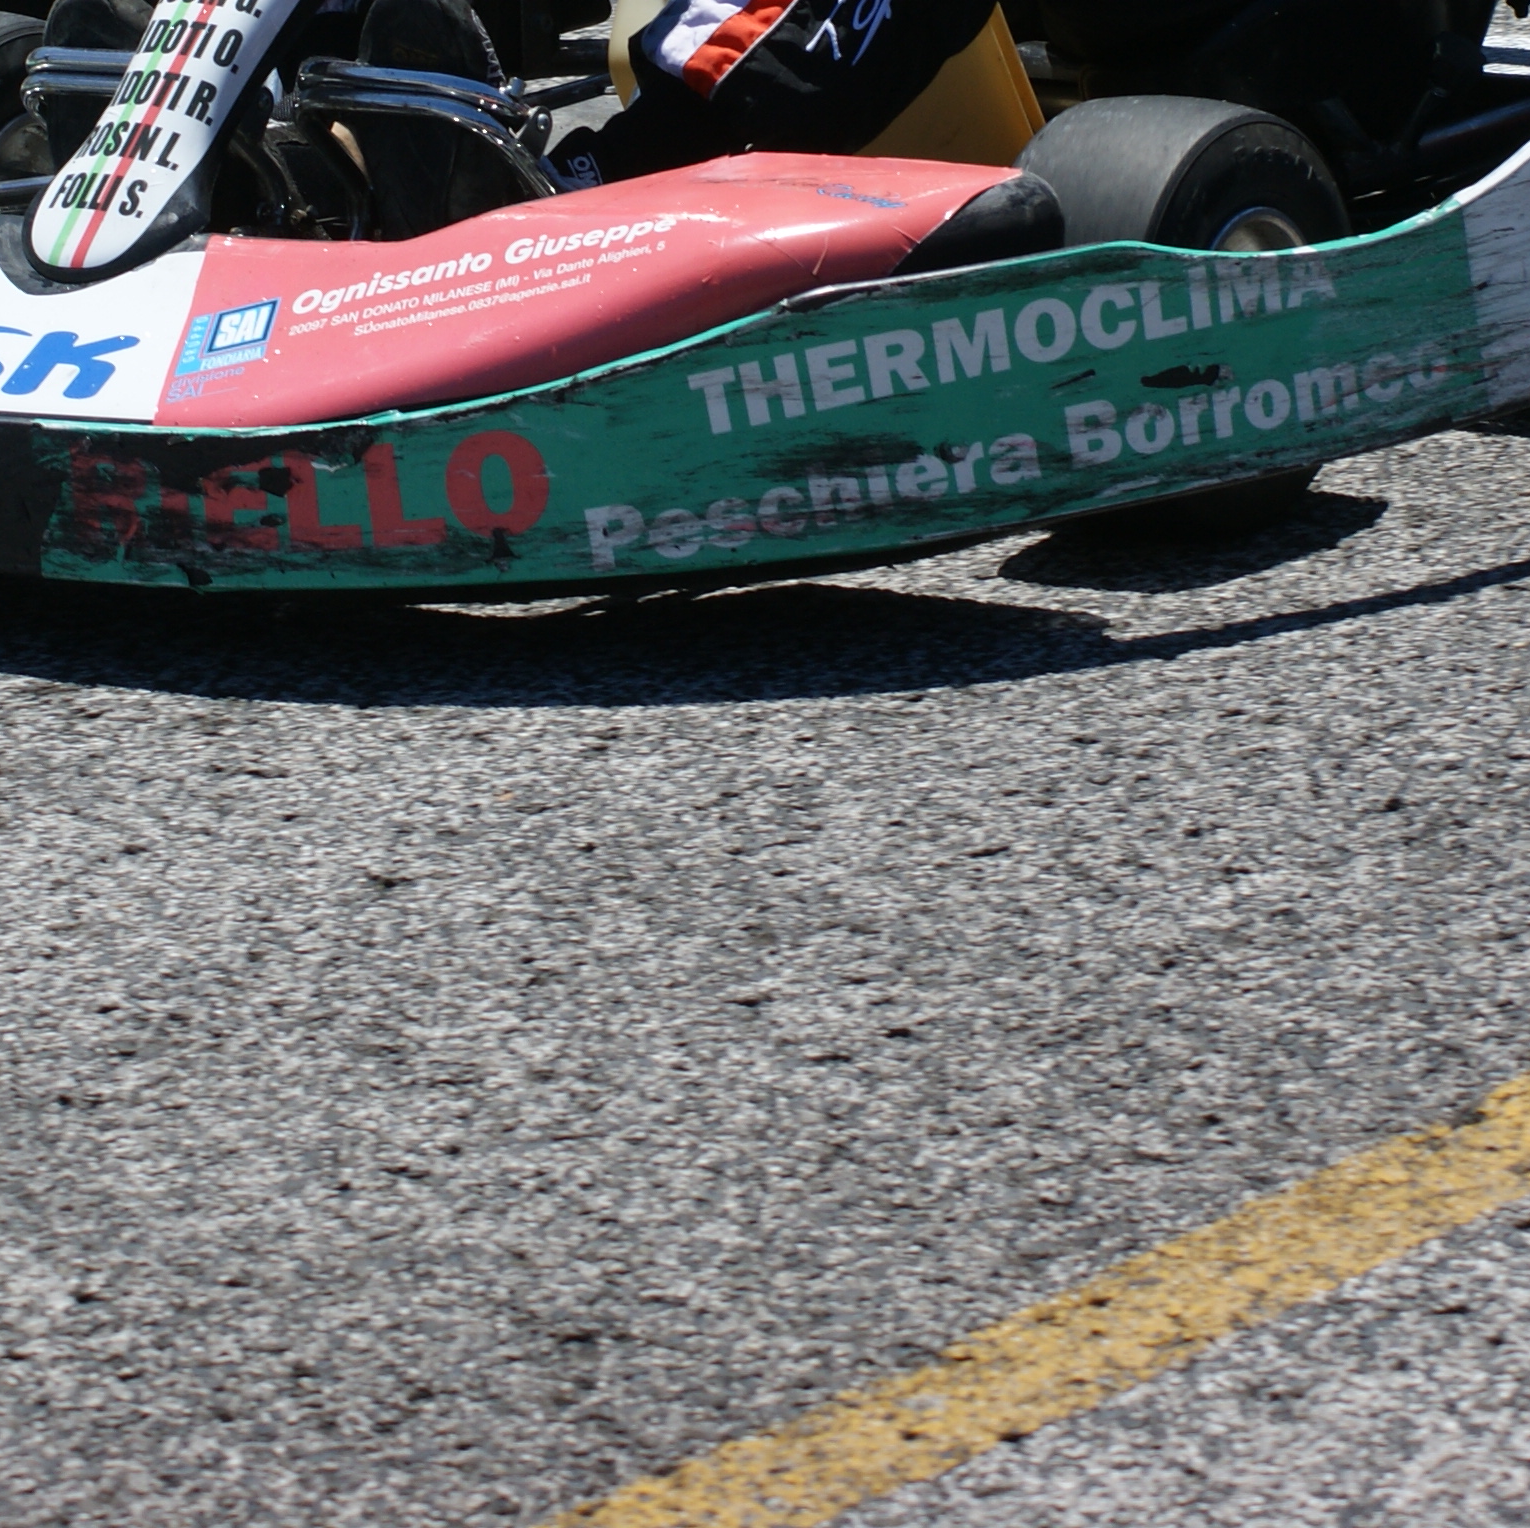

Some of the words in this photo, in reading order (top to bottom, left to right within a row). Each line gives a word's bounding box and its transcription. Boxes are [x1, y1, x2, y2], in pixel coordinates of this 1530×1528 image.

[212, 28, 245, 76] O.
[184, 79, 217, 127] R.
[154, 131, 182, 172] L.
[49, 171, 125, 213] FOLLI
[118, 178, 149, 219] S.
[288, 317, 328, 337] 20097
[329, 309, 359, 328] SAN
[361, 296, 419, 320] DONATO
[421, 279, 493, 307] MILANESE
[494, 274, 520, 292] (MI)
[533, 266, 554, 282] Via
[556, 257, 595, 276] Dante
[597, 243, 653, 266] Alighieri,
[655, 240, 667, 252] 5
[291, 248, 493, 316] Ognissanto
[503, 216, 678, 266] Giuseppe
[214, 305, 273, 348] SAI
[686, 257, 1338, 435] THERMOCLIMA
[171, 366, 246, 390] divisione
[200, 346, 264, 371] FONDIARIA
[165, 379, 205, 404] SAI
[583, 432, 1044, 573] Peschiera
